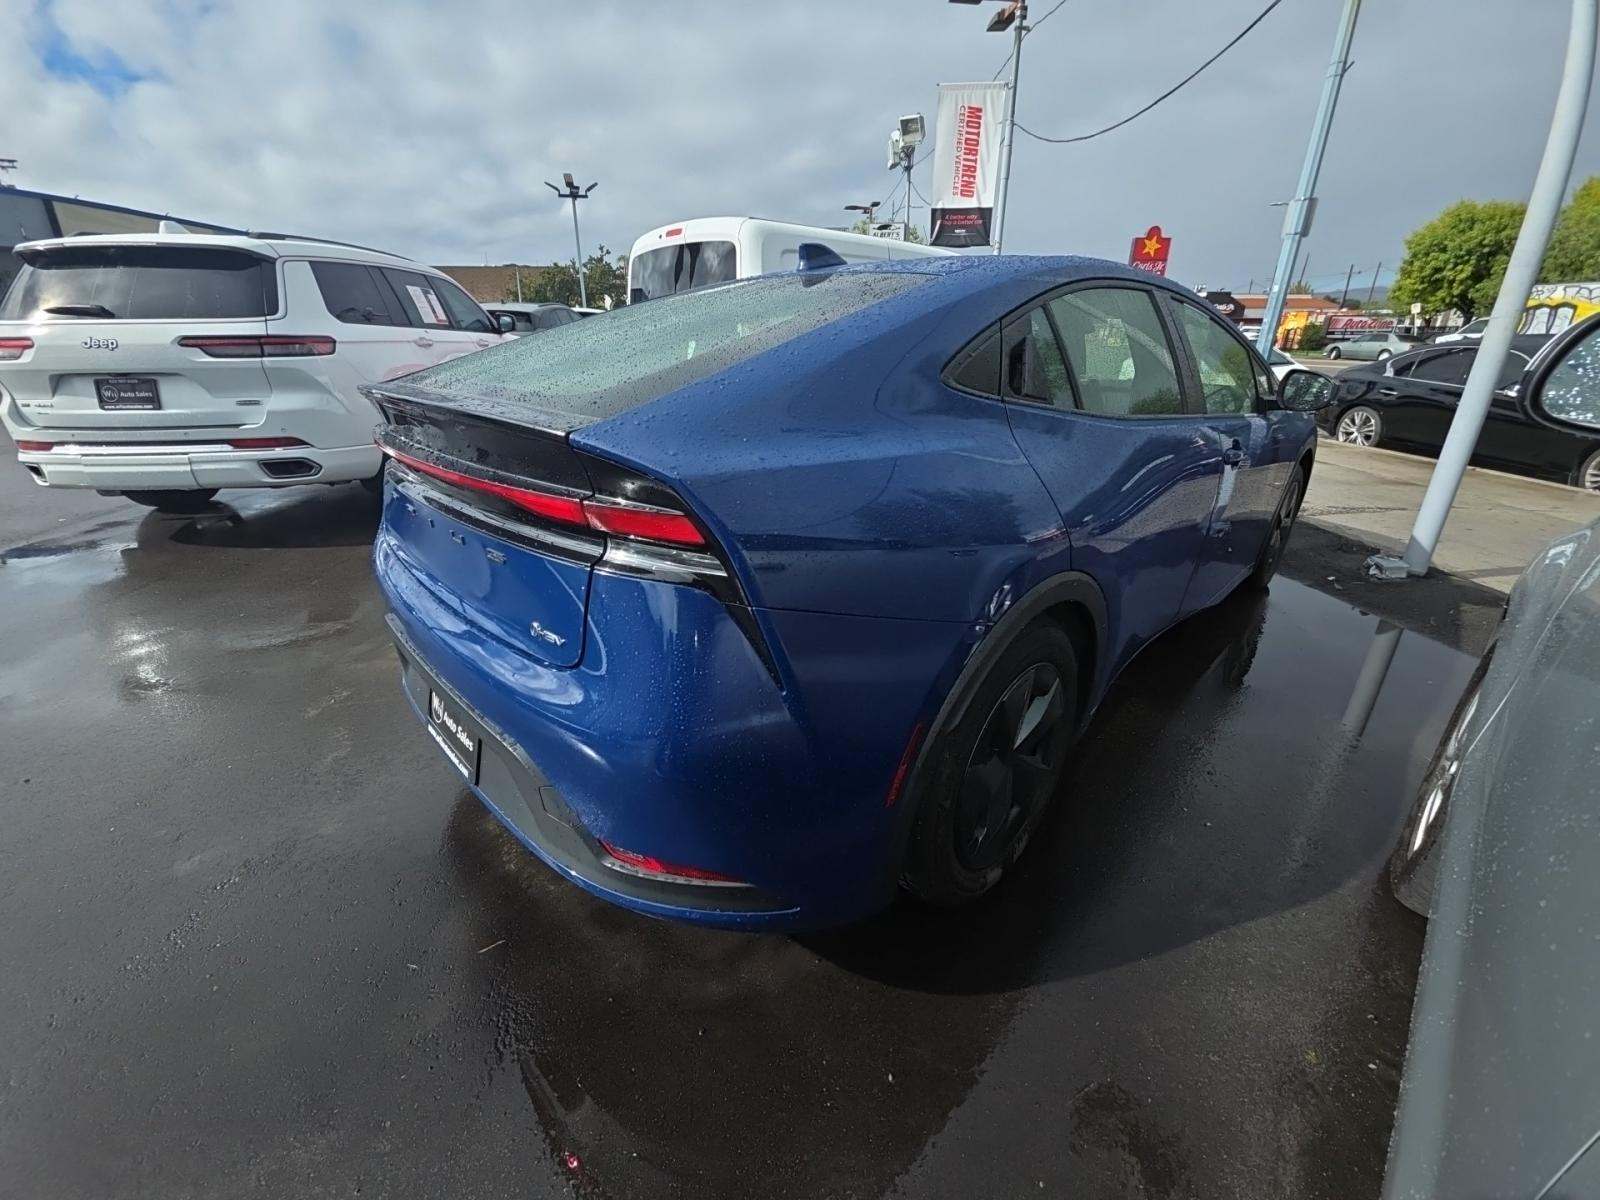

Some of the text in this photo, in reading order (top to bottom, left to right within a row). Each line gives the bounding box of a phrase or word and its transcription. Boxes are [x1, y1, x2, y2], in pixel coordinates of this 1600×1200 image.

[952, 105, 966, 197] CERTIFIED VEHICLES
[960, 105, 983, 198] MOTORTREND
[81, 336, 118, 351] Jeep
[443, 711, 457, 733] Auto
[456, 726, 474, 752] Sales
